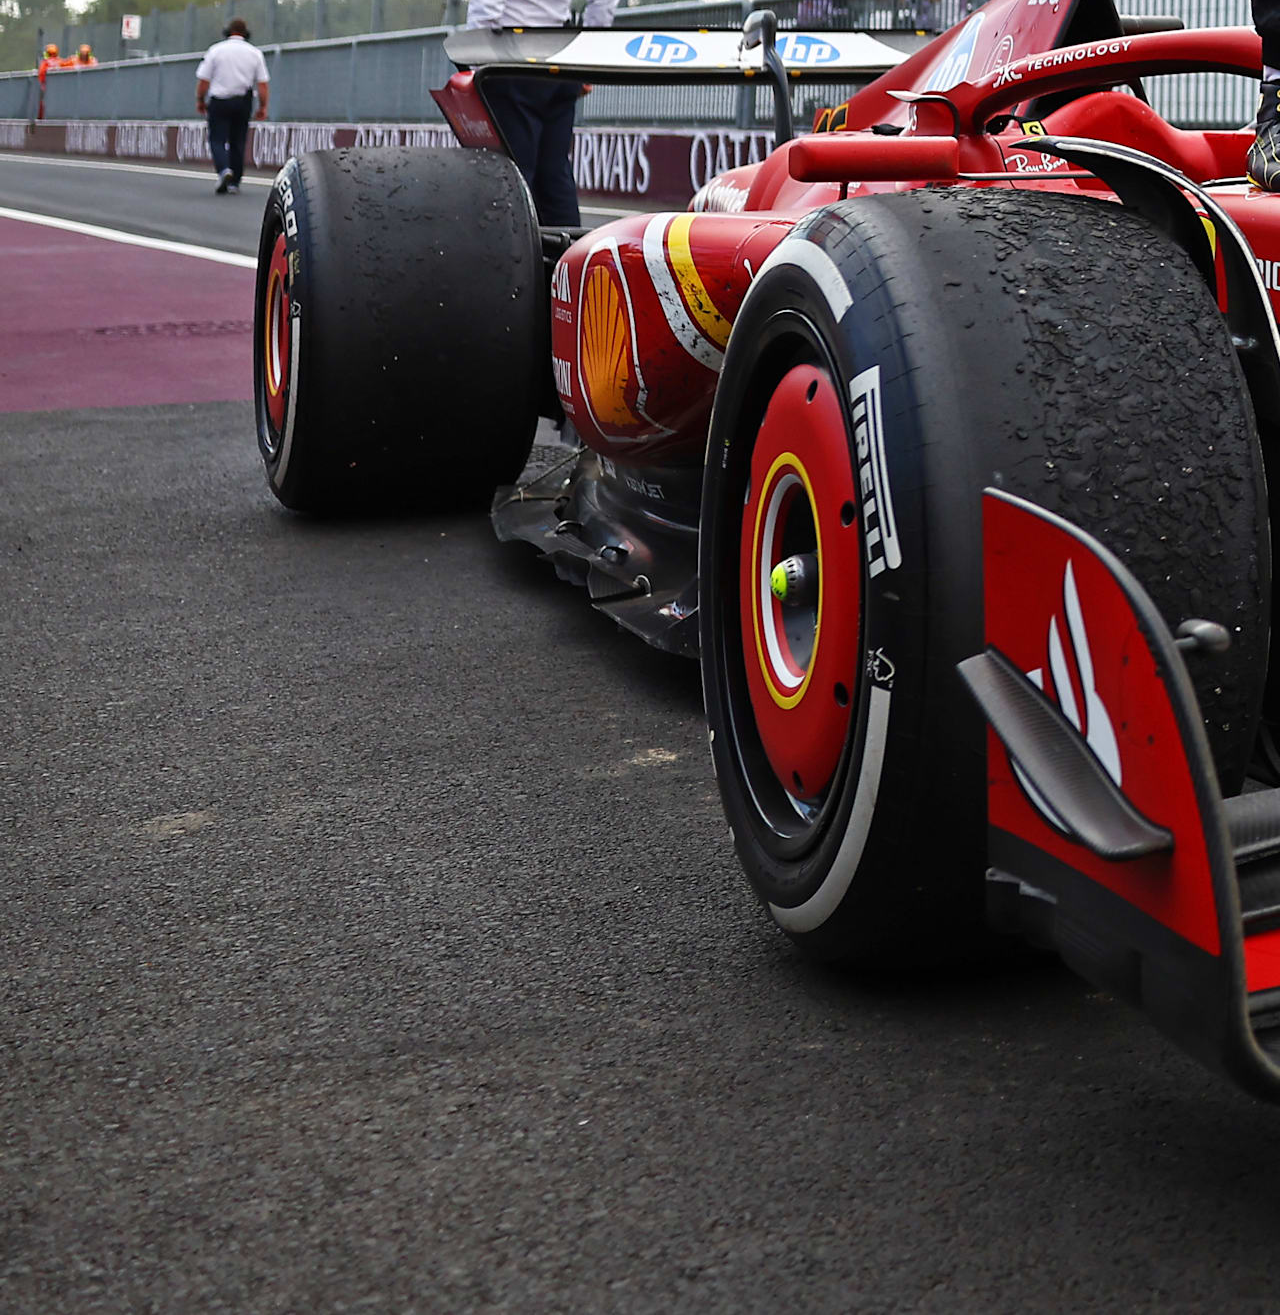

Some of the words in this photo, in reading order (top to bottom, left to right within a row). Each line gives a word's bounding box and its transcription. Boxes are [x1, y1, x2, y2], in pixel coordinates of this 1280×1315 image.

[634, 34, 691, 63] hp
[779, 35, 836, 64] hp
[1028, 39, 1132, 72] TECHNOLOGY
[570, 134, 651, 194] IRWAYS
[690, 133, 776, 194] QATA
[850, 365, 902, 579] PIRELLI
